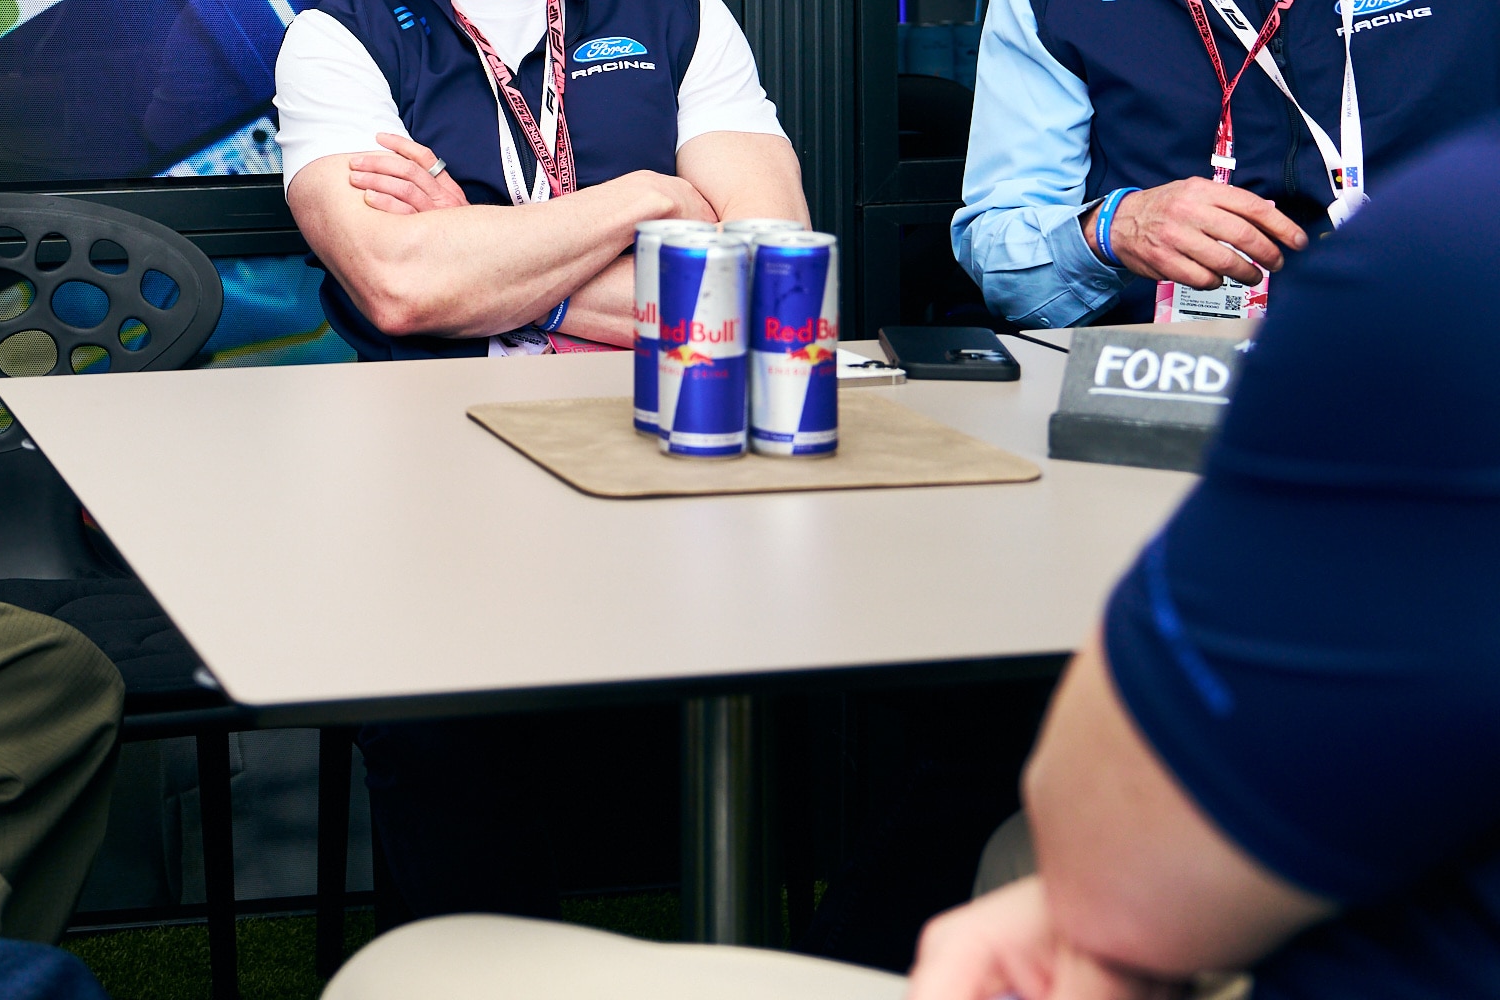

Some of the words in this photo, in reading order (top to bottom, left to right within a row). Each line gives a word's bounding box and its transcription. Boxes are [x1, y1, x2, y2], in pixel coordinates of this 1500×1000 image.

[586, 40, 633, 58] Ford
[571, 61, 656, 79] RACING
[689, 321, 736, 344] Bull
[765, 316, 814, 343] Red
[1094, 344, 1231, 394] FORD
